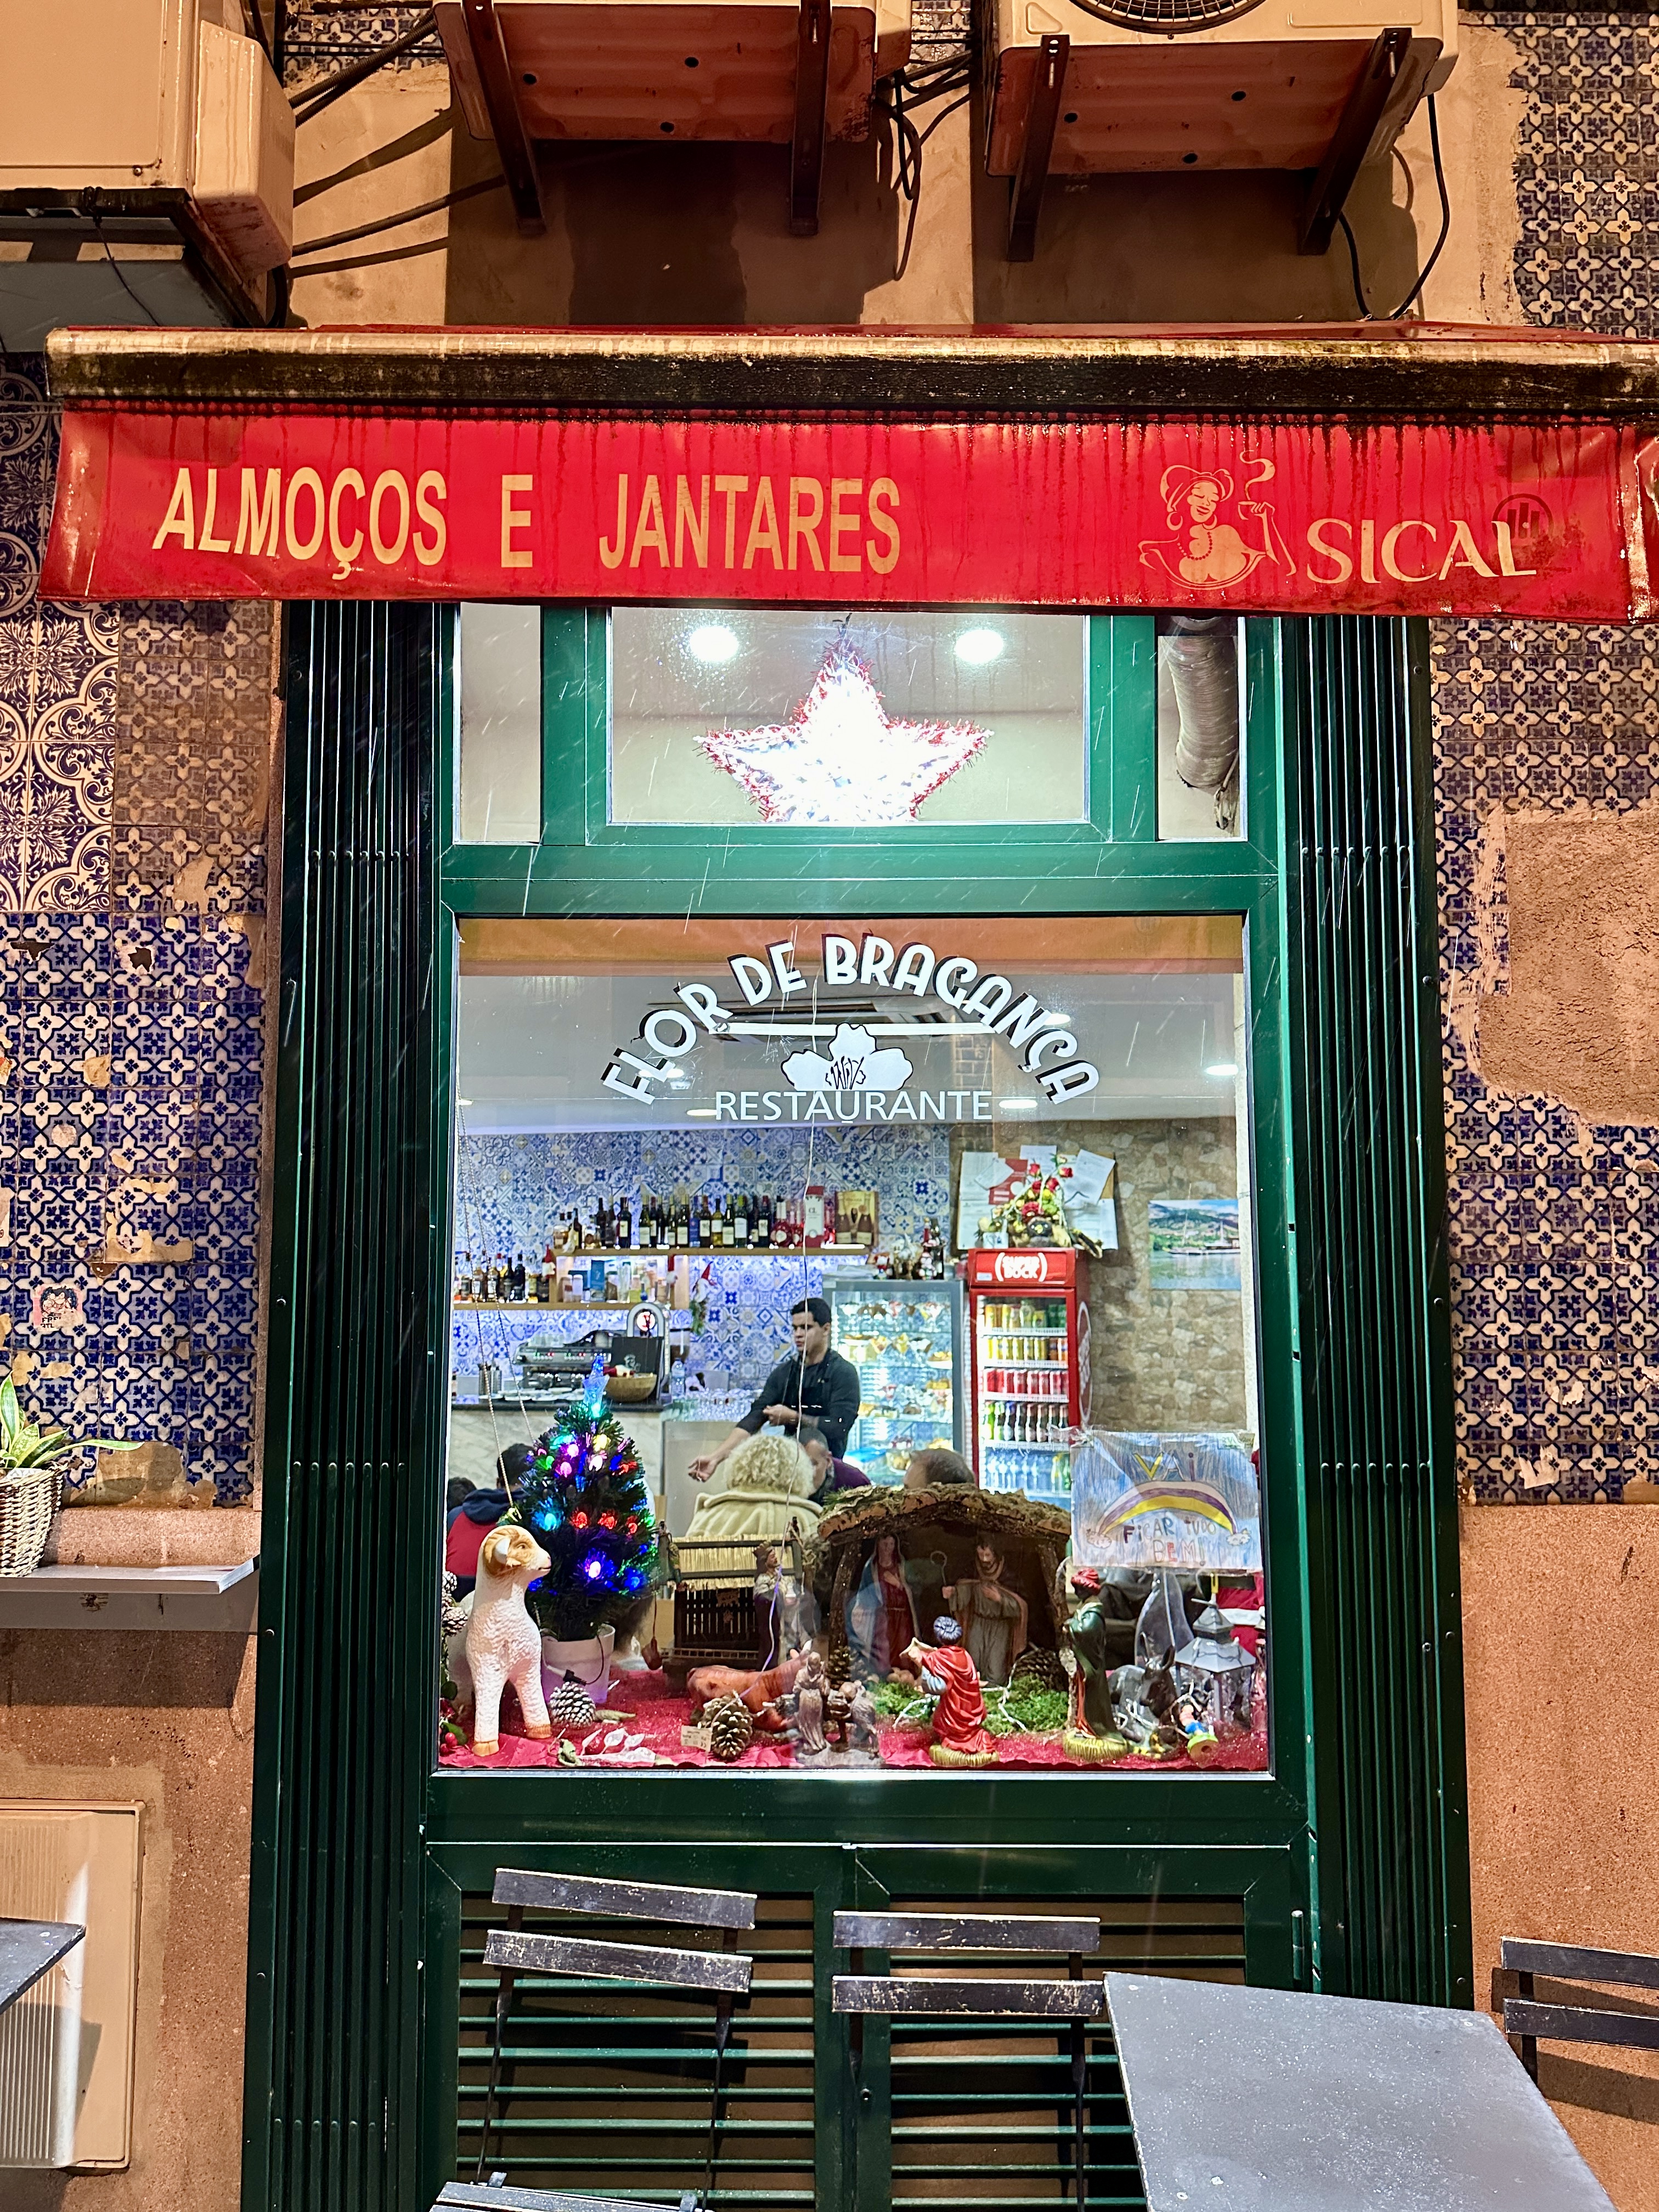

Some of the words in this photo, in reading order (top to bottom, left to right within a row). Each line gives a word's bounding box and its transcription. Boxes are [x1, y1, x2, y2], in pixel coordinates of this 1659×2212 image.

[153, 467, 447, 579] ALMOÇOS
[500, 473, 534, 569] E
[599, 473, 901, 574] JANTARES
[1308, 518, 1537, 584] SICAL
[601, 982, 732, 1105] FLOR
[728, 938, 809, 1007] DE
[822, 931, 1101, 1105] BRAGANÇA
[715, 1090, 994, 1124] RESTAURANTE
